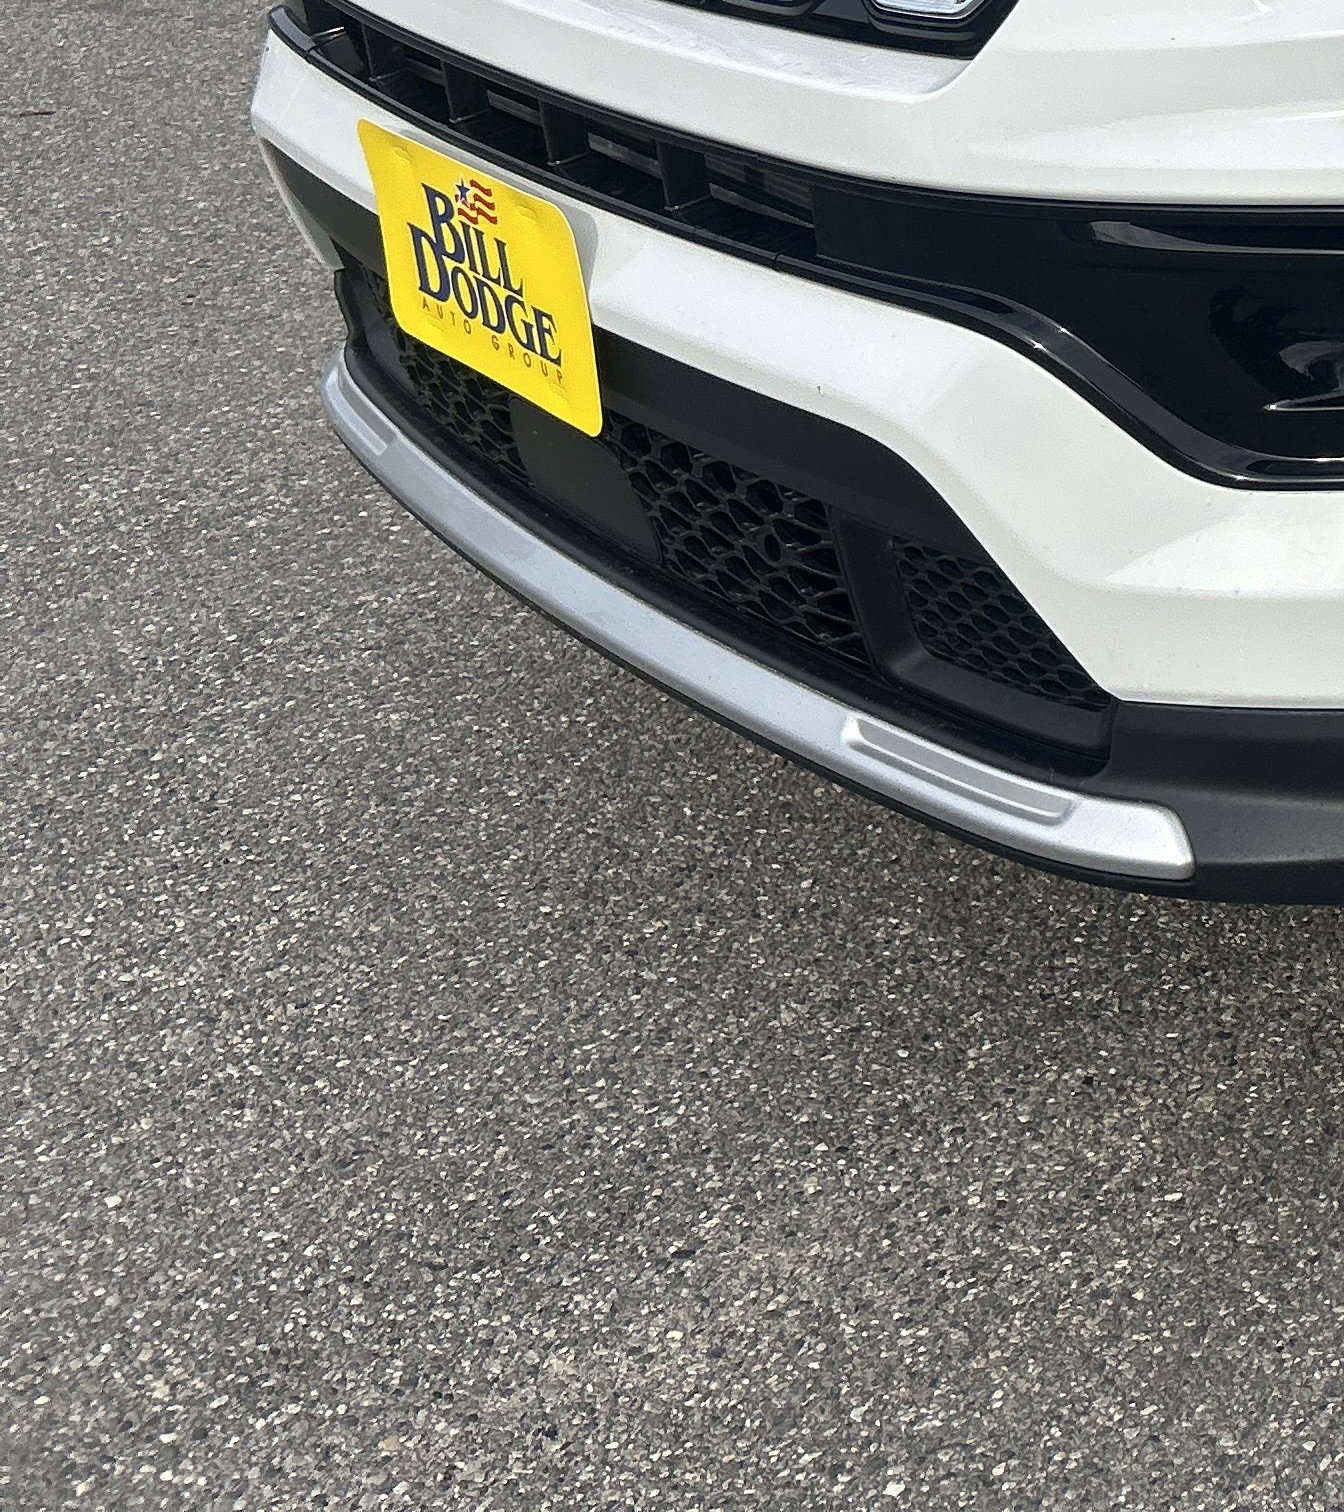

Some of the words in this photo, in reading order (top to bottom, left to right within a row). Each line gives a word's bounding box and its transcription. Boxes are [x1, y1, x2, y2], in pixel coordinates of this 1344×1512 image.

[406, 221, 562, 367] DODGE
[420, 182, 524, 297] BILL
[421, 296, 473, 335] AUTO
[490, 334, 564, 385] GROUP
